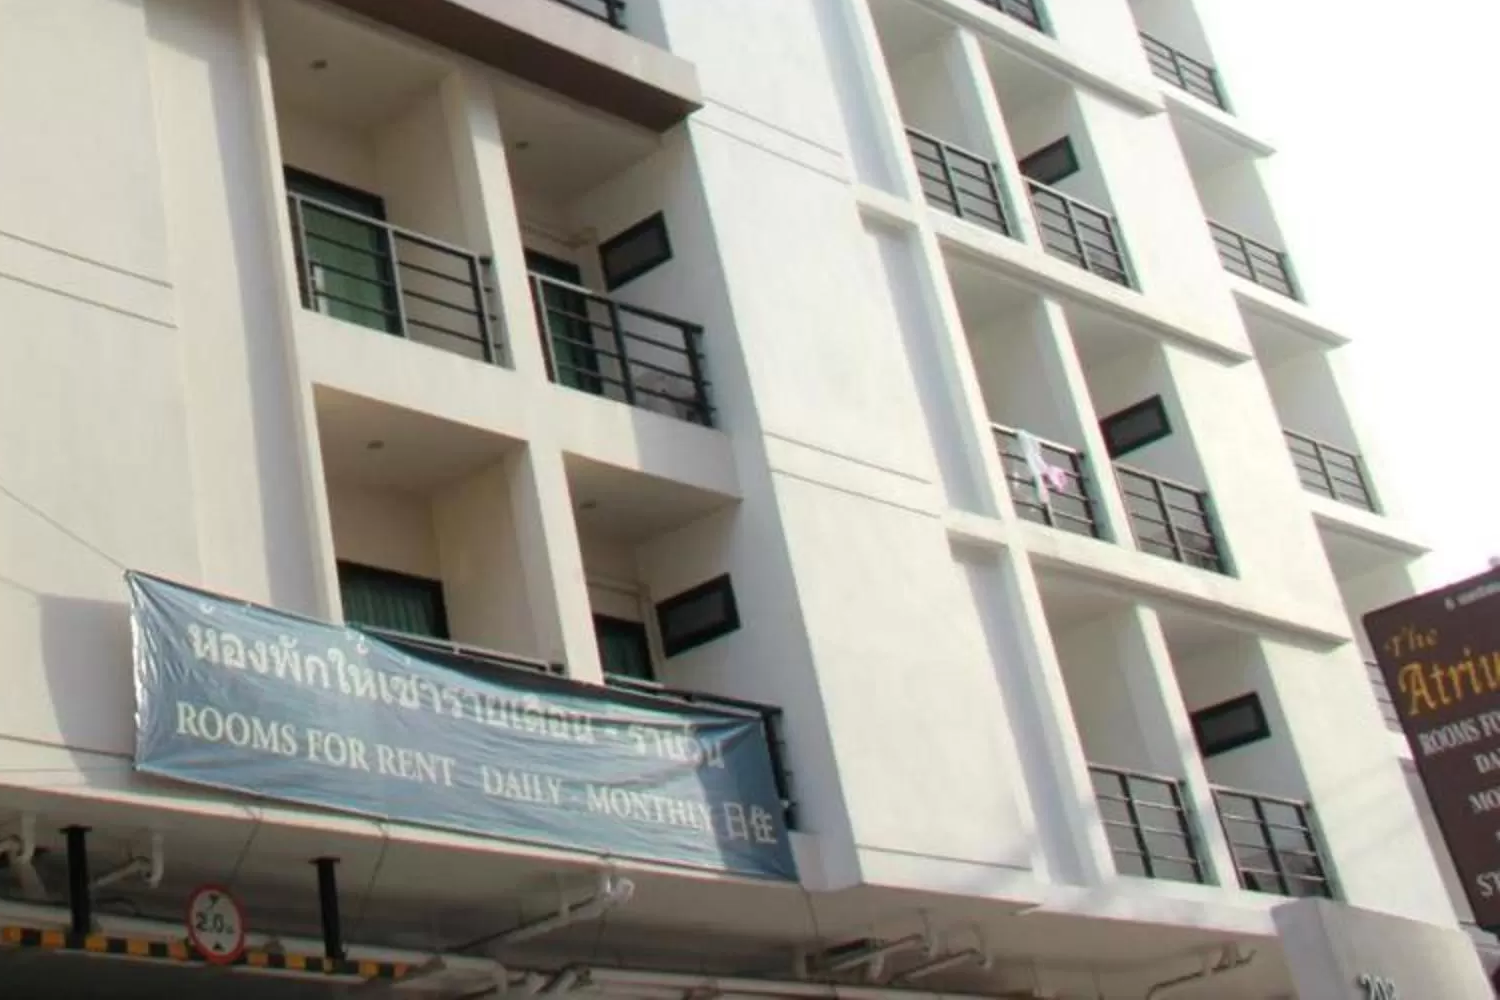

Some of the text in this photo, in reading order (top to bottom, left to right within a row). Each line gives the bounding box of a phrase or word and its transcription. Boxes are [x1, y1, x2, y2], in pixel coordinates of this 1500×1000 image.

[1384, 622, 1438, 657] The
[1417, 717, 1481, 756] ROOMS
[176, 701, 298, 757] ROOMS
[306, 727, 369, 772] FOR
[373, 742, 457, 788] RENT
[480, 764, 562, 805] DAILY
[586, 783, 713, 834] MONTHLY
